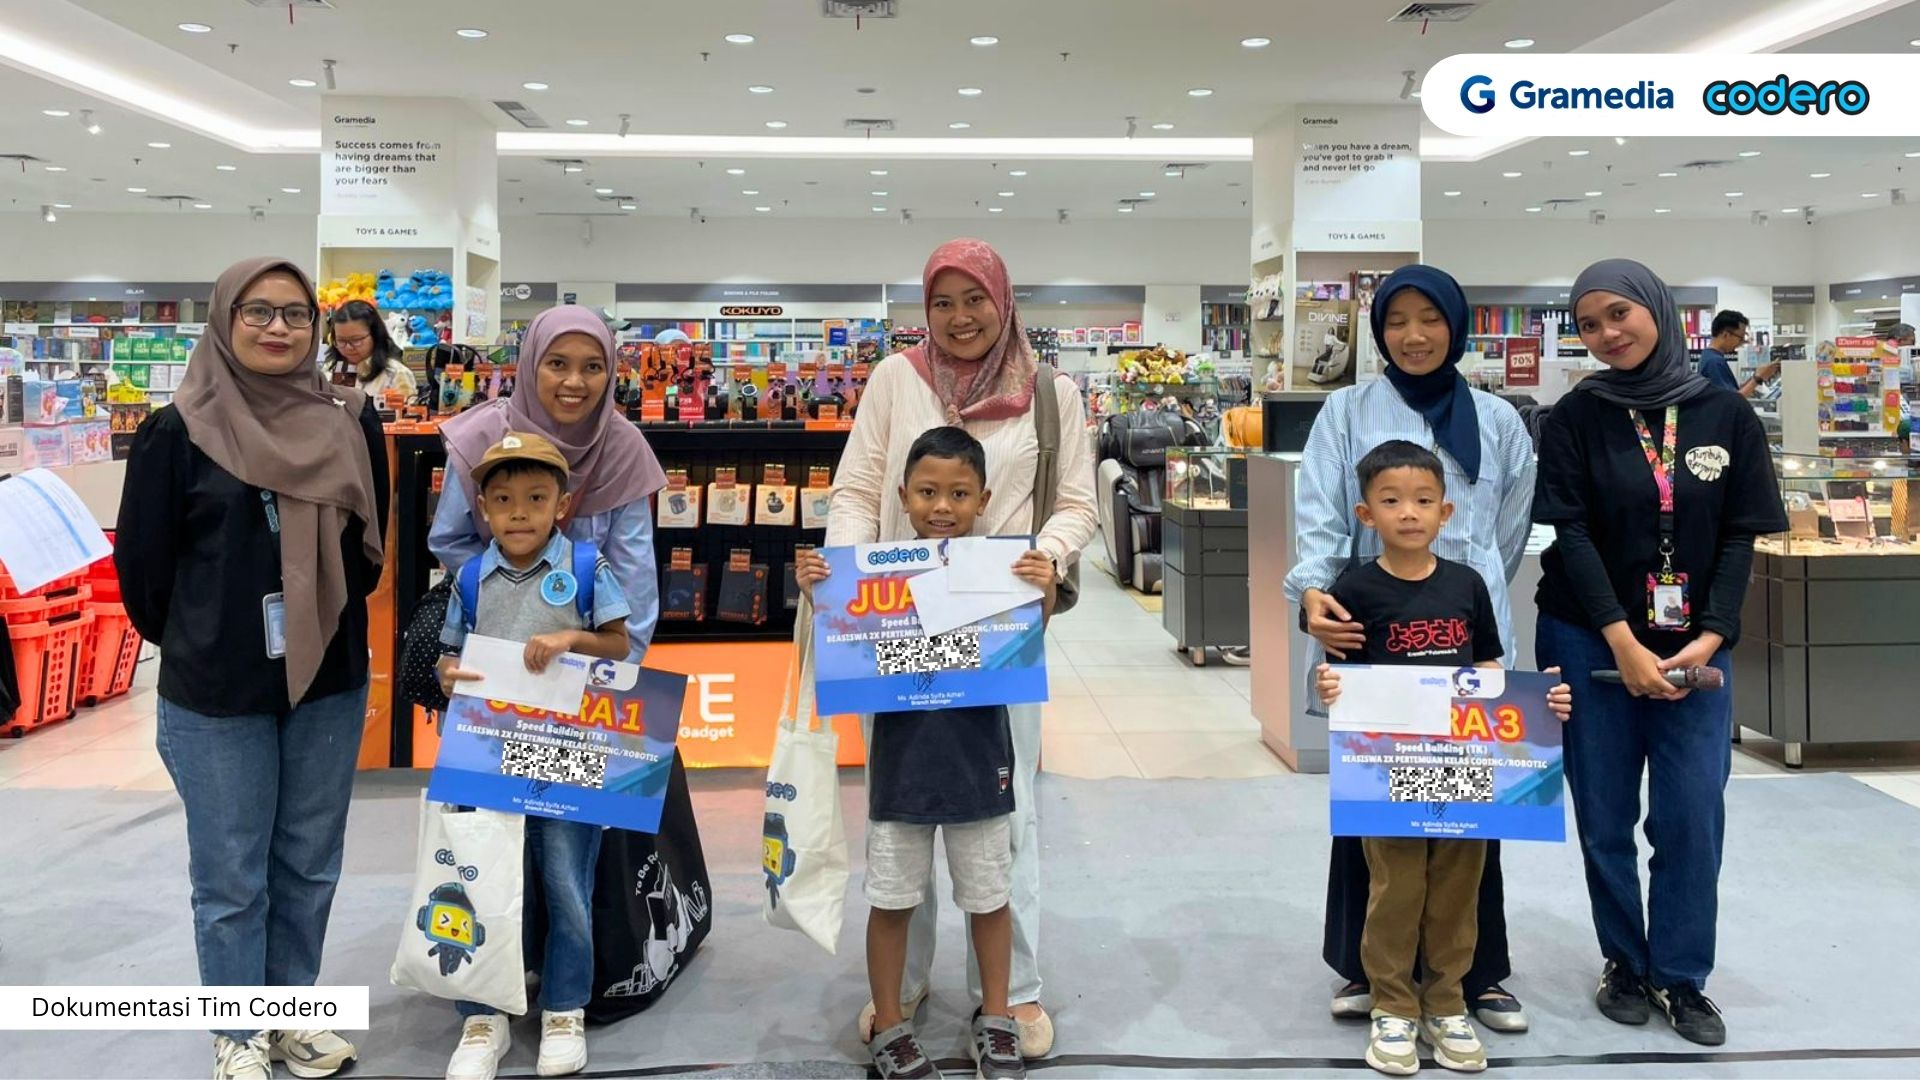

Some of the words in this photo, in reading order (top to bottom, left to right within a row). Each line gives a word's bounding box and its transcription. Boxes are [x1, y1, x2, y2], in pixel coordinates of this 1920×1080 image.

[334, 115, 376, 124] Gramedia
[1302, 117, 1338, 125] Gramedia
[335, 140, 377, 149] Success
[1331, 144, 1348, 152] you
[1381, 143, 1412, 152] dream,
[335, 153, 371, 163] having
[373, 153, 412, 162] dreams
[415, 153, 436, 162] that
[1302, 153, 1332, 162] you've
[1364, 153, 1385, 162] grab
[355, 164, 389, 174] bigger
[392, 165, 416, 173] than
[335, 177, 359, 186] your
[361, 176, 388, 185] fears
[387, 228, 418, 236] GAMES
[722, 307, 781, 315] KOKUYO
[1309, 312, 1348, 323] DIVINE
[1513, 356, 1533, 366] 70%
[868, 547, 930, 565] codero
[849, 579, 917, 614] JUA
[881, 617, 909, 629] Speed
[826, 632, 868, 644] BEASISWA
[868, 631, 880, 640] 2X
[881, 628, 924, 640] PERTEMUA
[1386, 618, 1469, 652] ようさい
[622, 703, 643, 732] 1
[1498, 708, 1521, 739] 3
[516, 719, 545, 732] Speed
[547, 723, 585, 740] Building
[587, 730, 608, 742] (TK)
[679, 725, 735, 741] Gadget
[456, 723, 500, 737] BEASISWA
[500, 730, 512, 739] 2X
[512, 731, 562, 746] PERTEMUAN
[562, 738, 587, 750] KELAS
[588, 743, 660, 763] CODING/ROBOTIC
[1395, 742, 1423, 754] Speed
[1425, 742, 1464, 755] Building
[1466, 744, 1488, 755] (TK)
[1342, 754, 1382, 763] BEASISWA
[1383, 755, 1394, 763] 2X
[1395, 755, 1443, 764] PERTEMUAN
[1445, 756, 1469, 765] KELAS
[1471, 757, 1548, 769] CODING/ROBOTIC
[637, 863, 650, 879] Be
